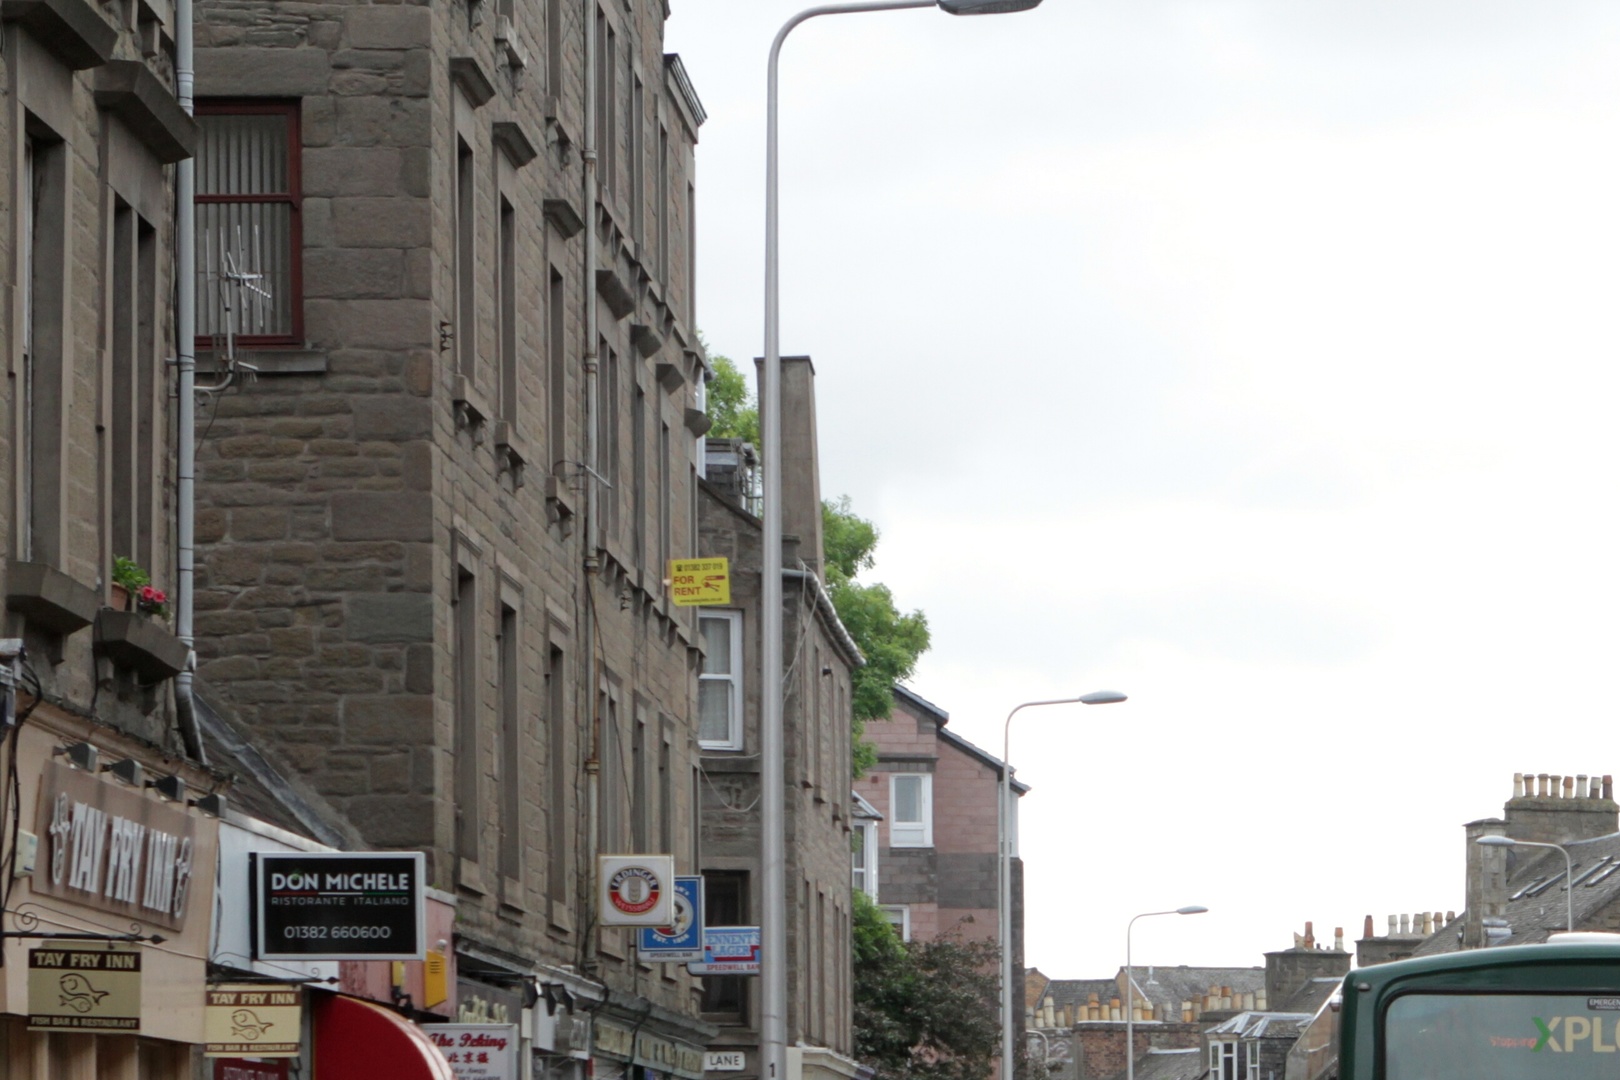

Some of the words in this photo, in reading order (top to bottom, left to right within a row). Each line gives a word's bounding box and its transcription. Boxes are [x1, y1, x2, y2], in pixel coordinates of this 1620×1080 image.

[673, 575, 695, 585] FOR
[674, 586, 702, 596] RENT
[69, 802, 107, 893] TAY
[105, 815, 145, 904] FRY
[272, 873, 319, 890] DON
[326, 873, 409, 890] MICHELE
[611, 868, 659, 888] ERDINGER
[271, 897, 346, 906] RISTORANTE
[354, 897, 409, 906] ITALIANO
[284, 926, 327, 939] 01382
[331, 926, 391, 939] 660600
[711, 945, 752, 956] LAGER
[34, 952, 66, 966] TAY
[70, 953, 102, 968] FRY
[106, 954, 136, 968] INN
[211, 993, 237, 1004] TAY
[240, 993, 268, 1004] FRY
[270, 993, 296, 1004] INN
[80, 1018, 136, 1028] RESTAURANT
[429, 1032, 455, 1047] The
[458, 1032, 508, 1052] Peking
[710, 1056, 740, 1066] LANE
